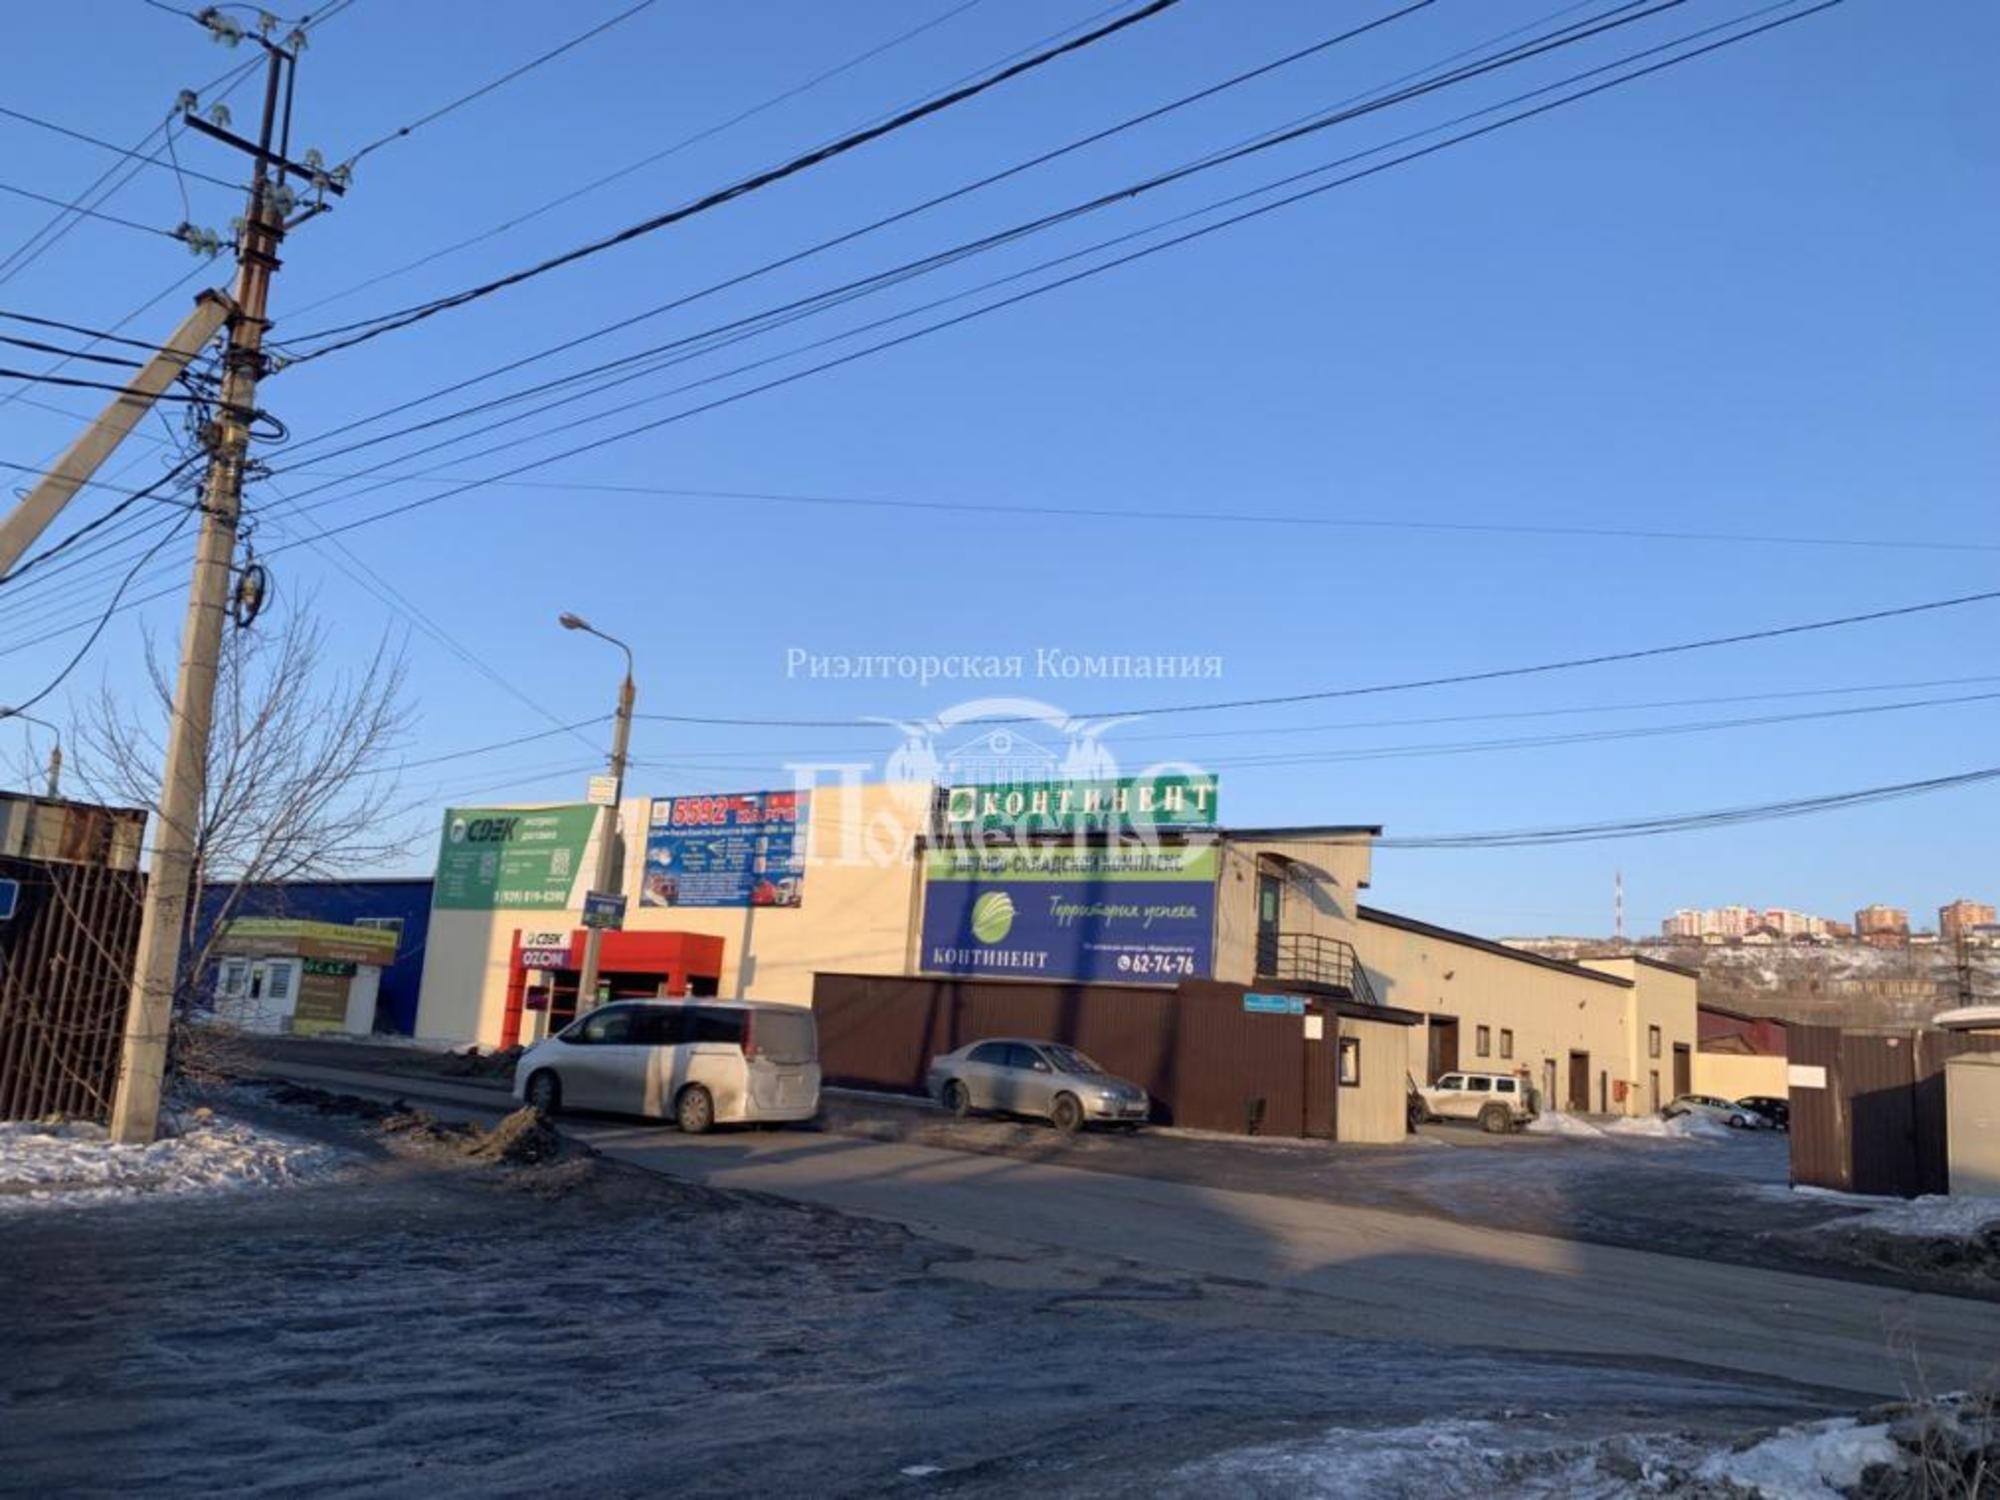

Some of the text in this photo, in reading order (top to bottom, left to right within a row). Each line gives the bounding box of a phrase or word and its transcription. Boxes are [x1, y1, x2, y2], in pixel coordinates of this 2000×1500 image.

[982, 783, 1214, 817] КОНТИНЕНТ
[467, 817, 519, 843] CDEK
[1049, 896, 1197, 928] Территория успеха
[933, 948, 1048, 969] КОНТИНЕНТ
[1132, 954, 1195, 975] 62-74-76
